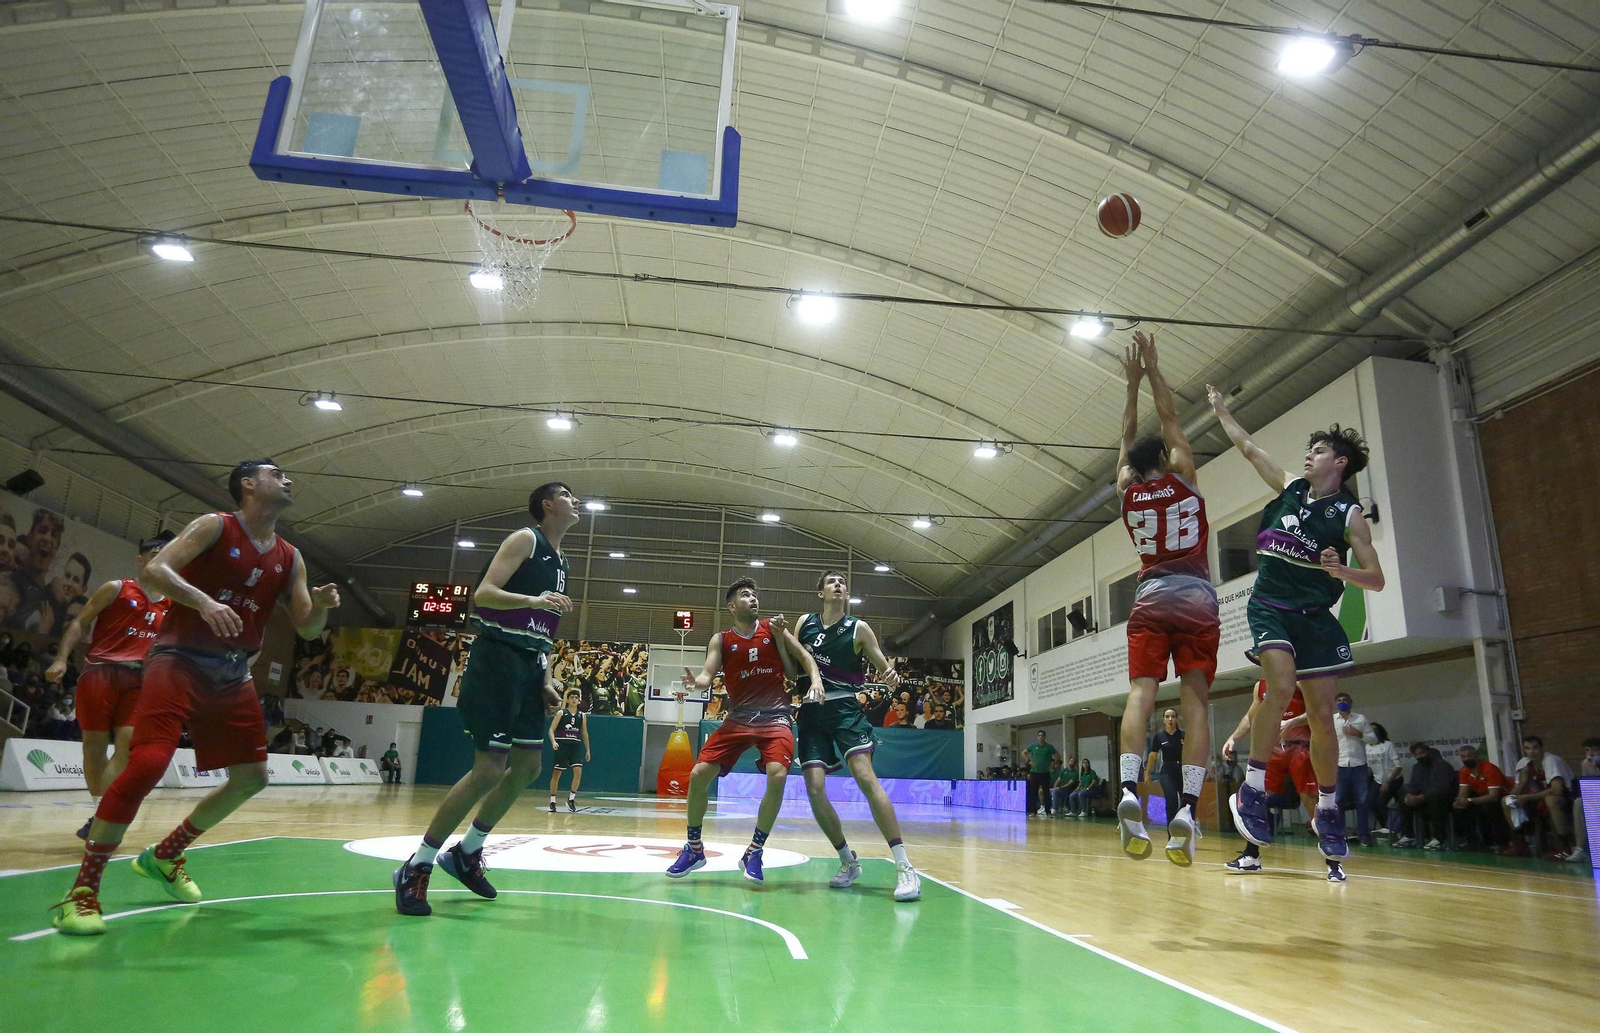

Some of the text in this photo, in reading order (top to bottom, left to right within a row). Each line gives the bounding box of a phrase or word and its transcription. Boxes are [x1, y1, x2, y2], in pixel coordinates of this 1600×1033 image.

[1293, 527, 1319, 550] Uicaja
[556, 568, 566, 593] 15
[415, 583, 429, 594] 95
[437, 589, 443, 597] 4
[453, 585, 468, 596] 81
[1225, 593, 1235, 604] QUE
[1235, 589, 1246, 600] HAN
[423, 601, 453, 613] 02:55
[144, 611, 157, 625] 4
[413, 609, 419, 618] 5
[459, 612, 466, 621] 4
[683, 618, 691, 629] 5
[813, 632, 827, 647] 5
[748, 647, 759, 663] 2
